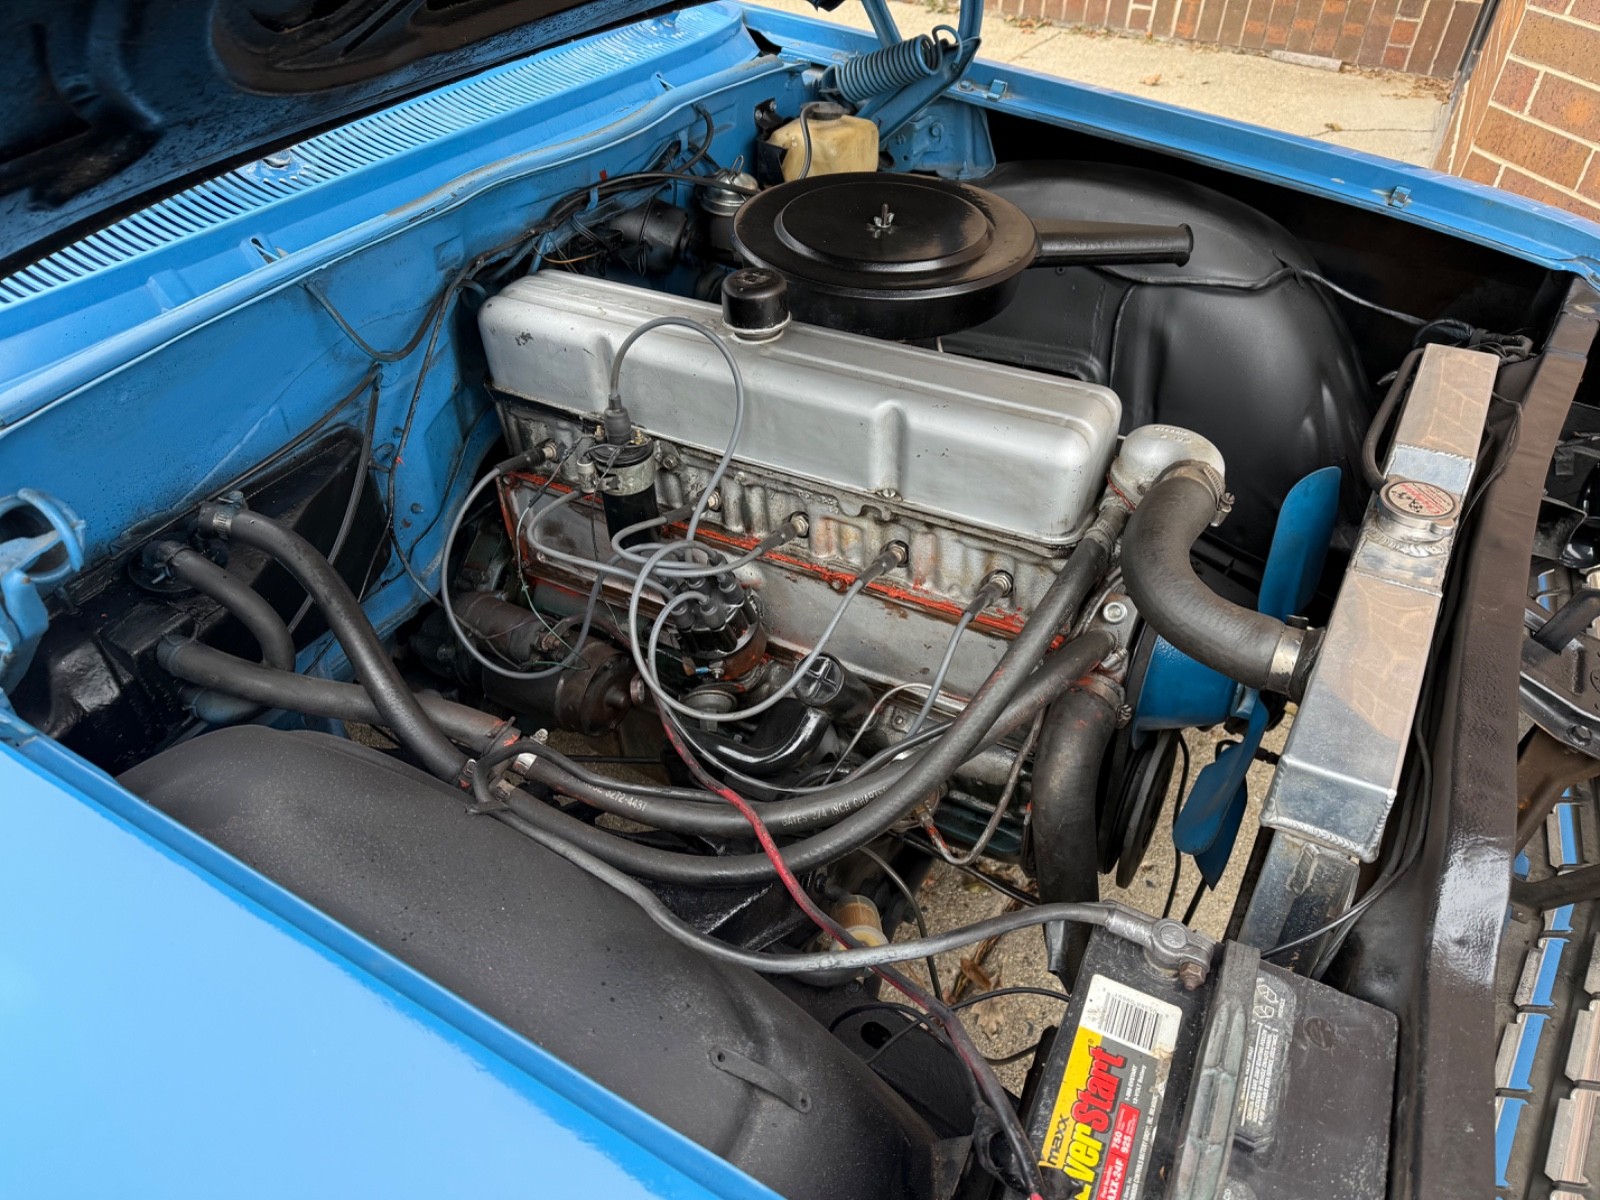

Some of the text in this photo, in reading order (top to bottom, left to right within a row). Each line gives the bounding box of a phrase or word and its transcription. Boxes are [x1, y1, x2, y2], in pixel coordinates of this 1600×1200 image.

[831, 801, 852, 816] INCH
[1047, 1113, 1070, 1166] maxx
[1111, 1131, 1123, 1149] 750
[1120, 1134, 1131, 1154] 925
